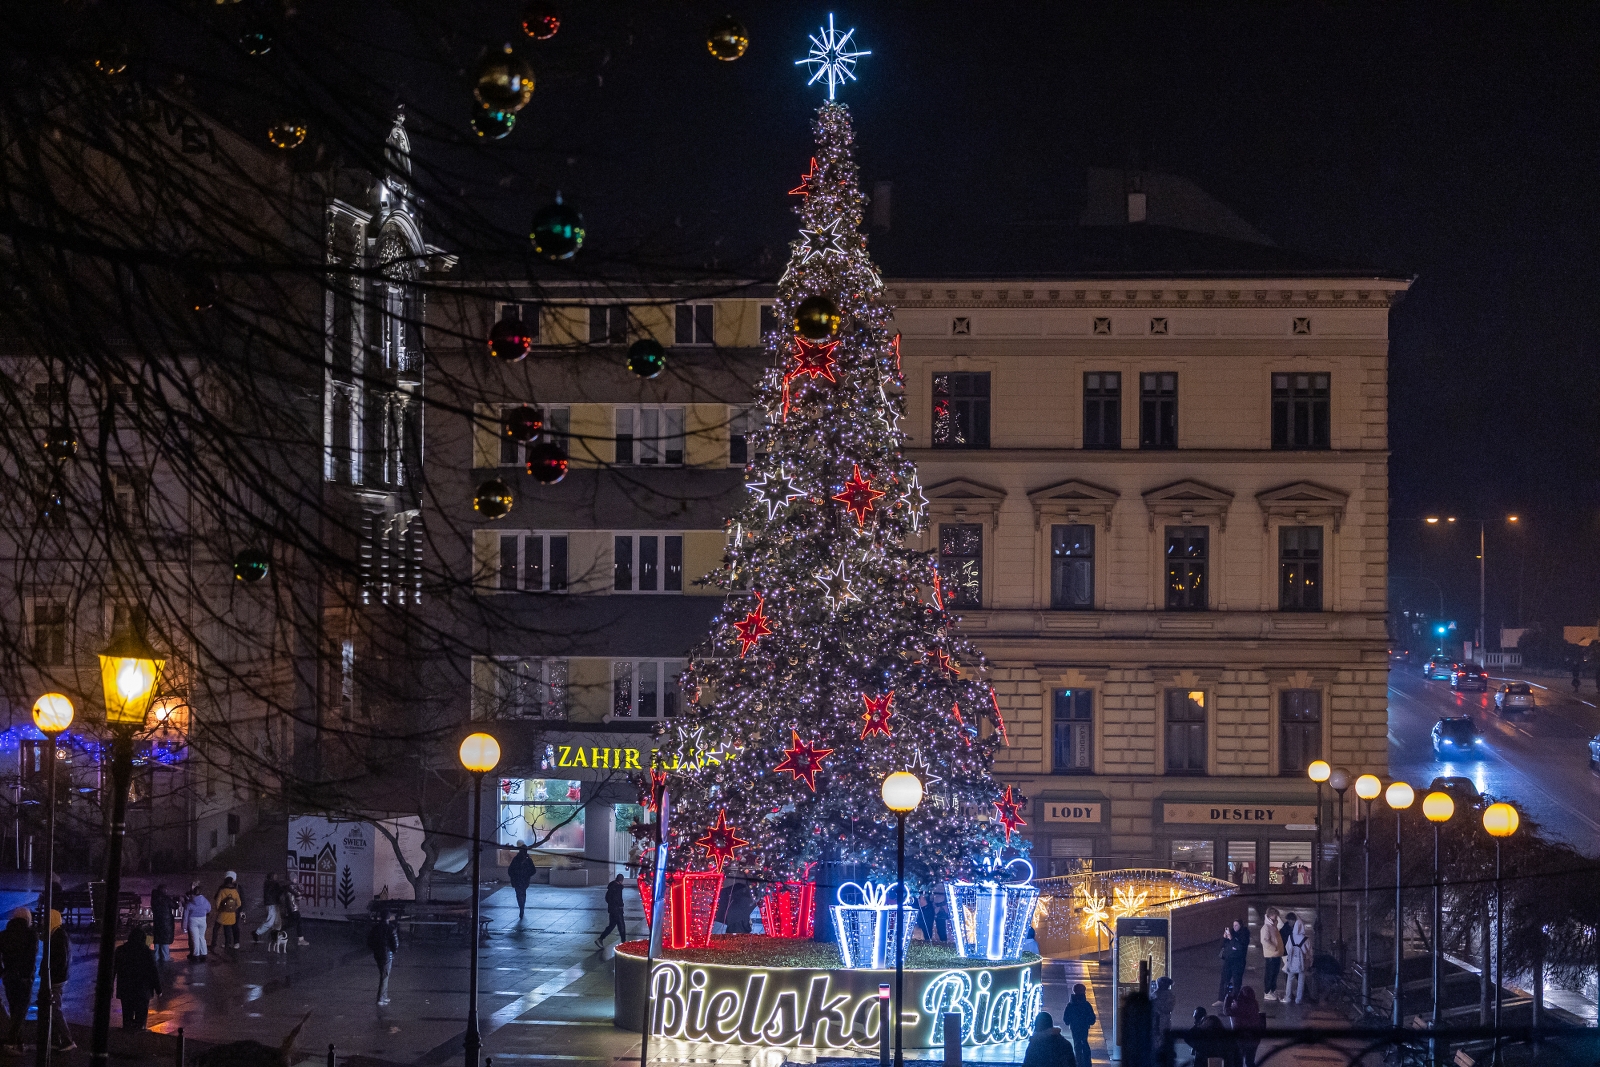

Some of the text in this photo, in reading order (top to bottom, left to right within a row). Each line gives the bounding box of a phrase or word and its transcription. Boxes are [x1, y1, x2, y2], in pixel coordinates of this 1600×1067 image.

[558, 745, 643, 770] ZAHIR
[1052, 807, 1093, 819] LODY
[1210, 808, 1276, 821] DESERY
